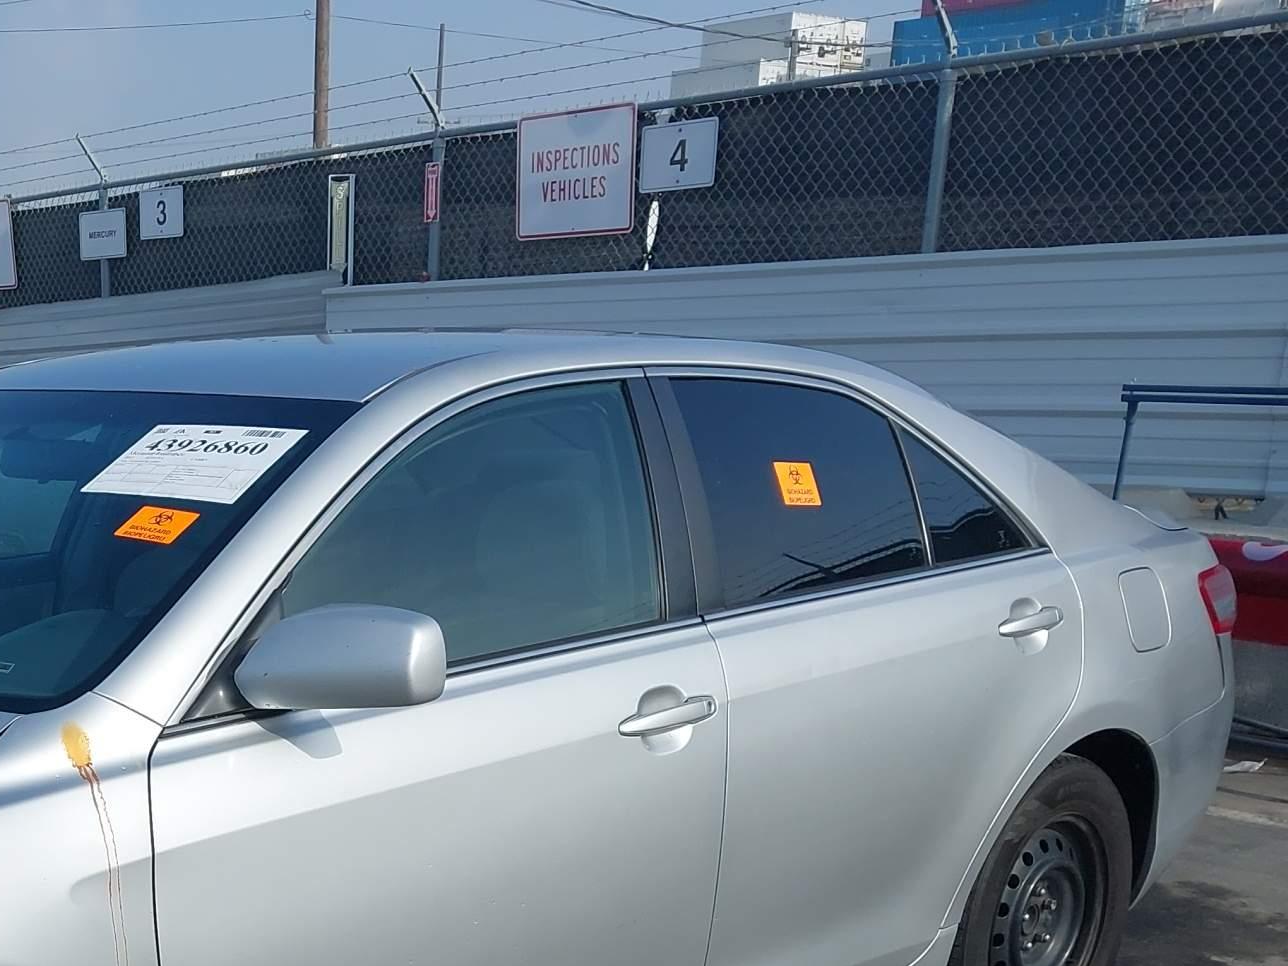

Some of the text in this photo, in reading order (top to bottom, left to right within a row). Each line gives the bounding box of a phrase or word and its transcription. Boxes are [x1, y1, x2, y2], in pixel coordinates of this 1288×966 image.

[531, 142, 620, 174] INSPECTIONS
[669, 139, 689, 172] 4
[542, 176, 606, 202] VEHICLES
[156, 200, 167, 226] 3
[88, 230, 116, 239] MERCURY
[145, 438, 269, 456] 43926860
